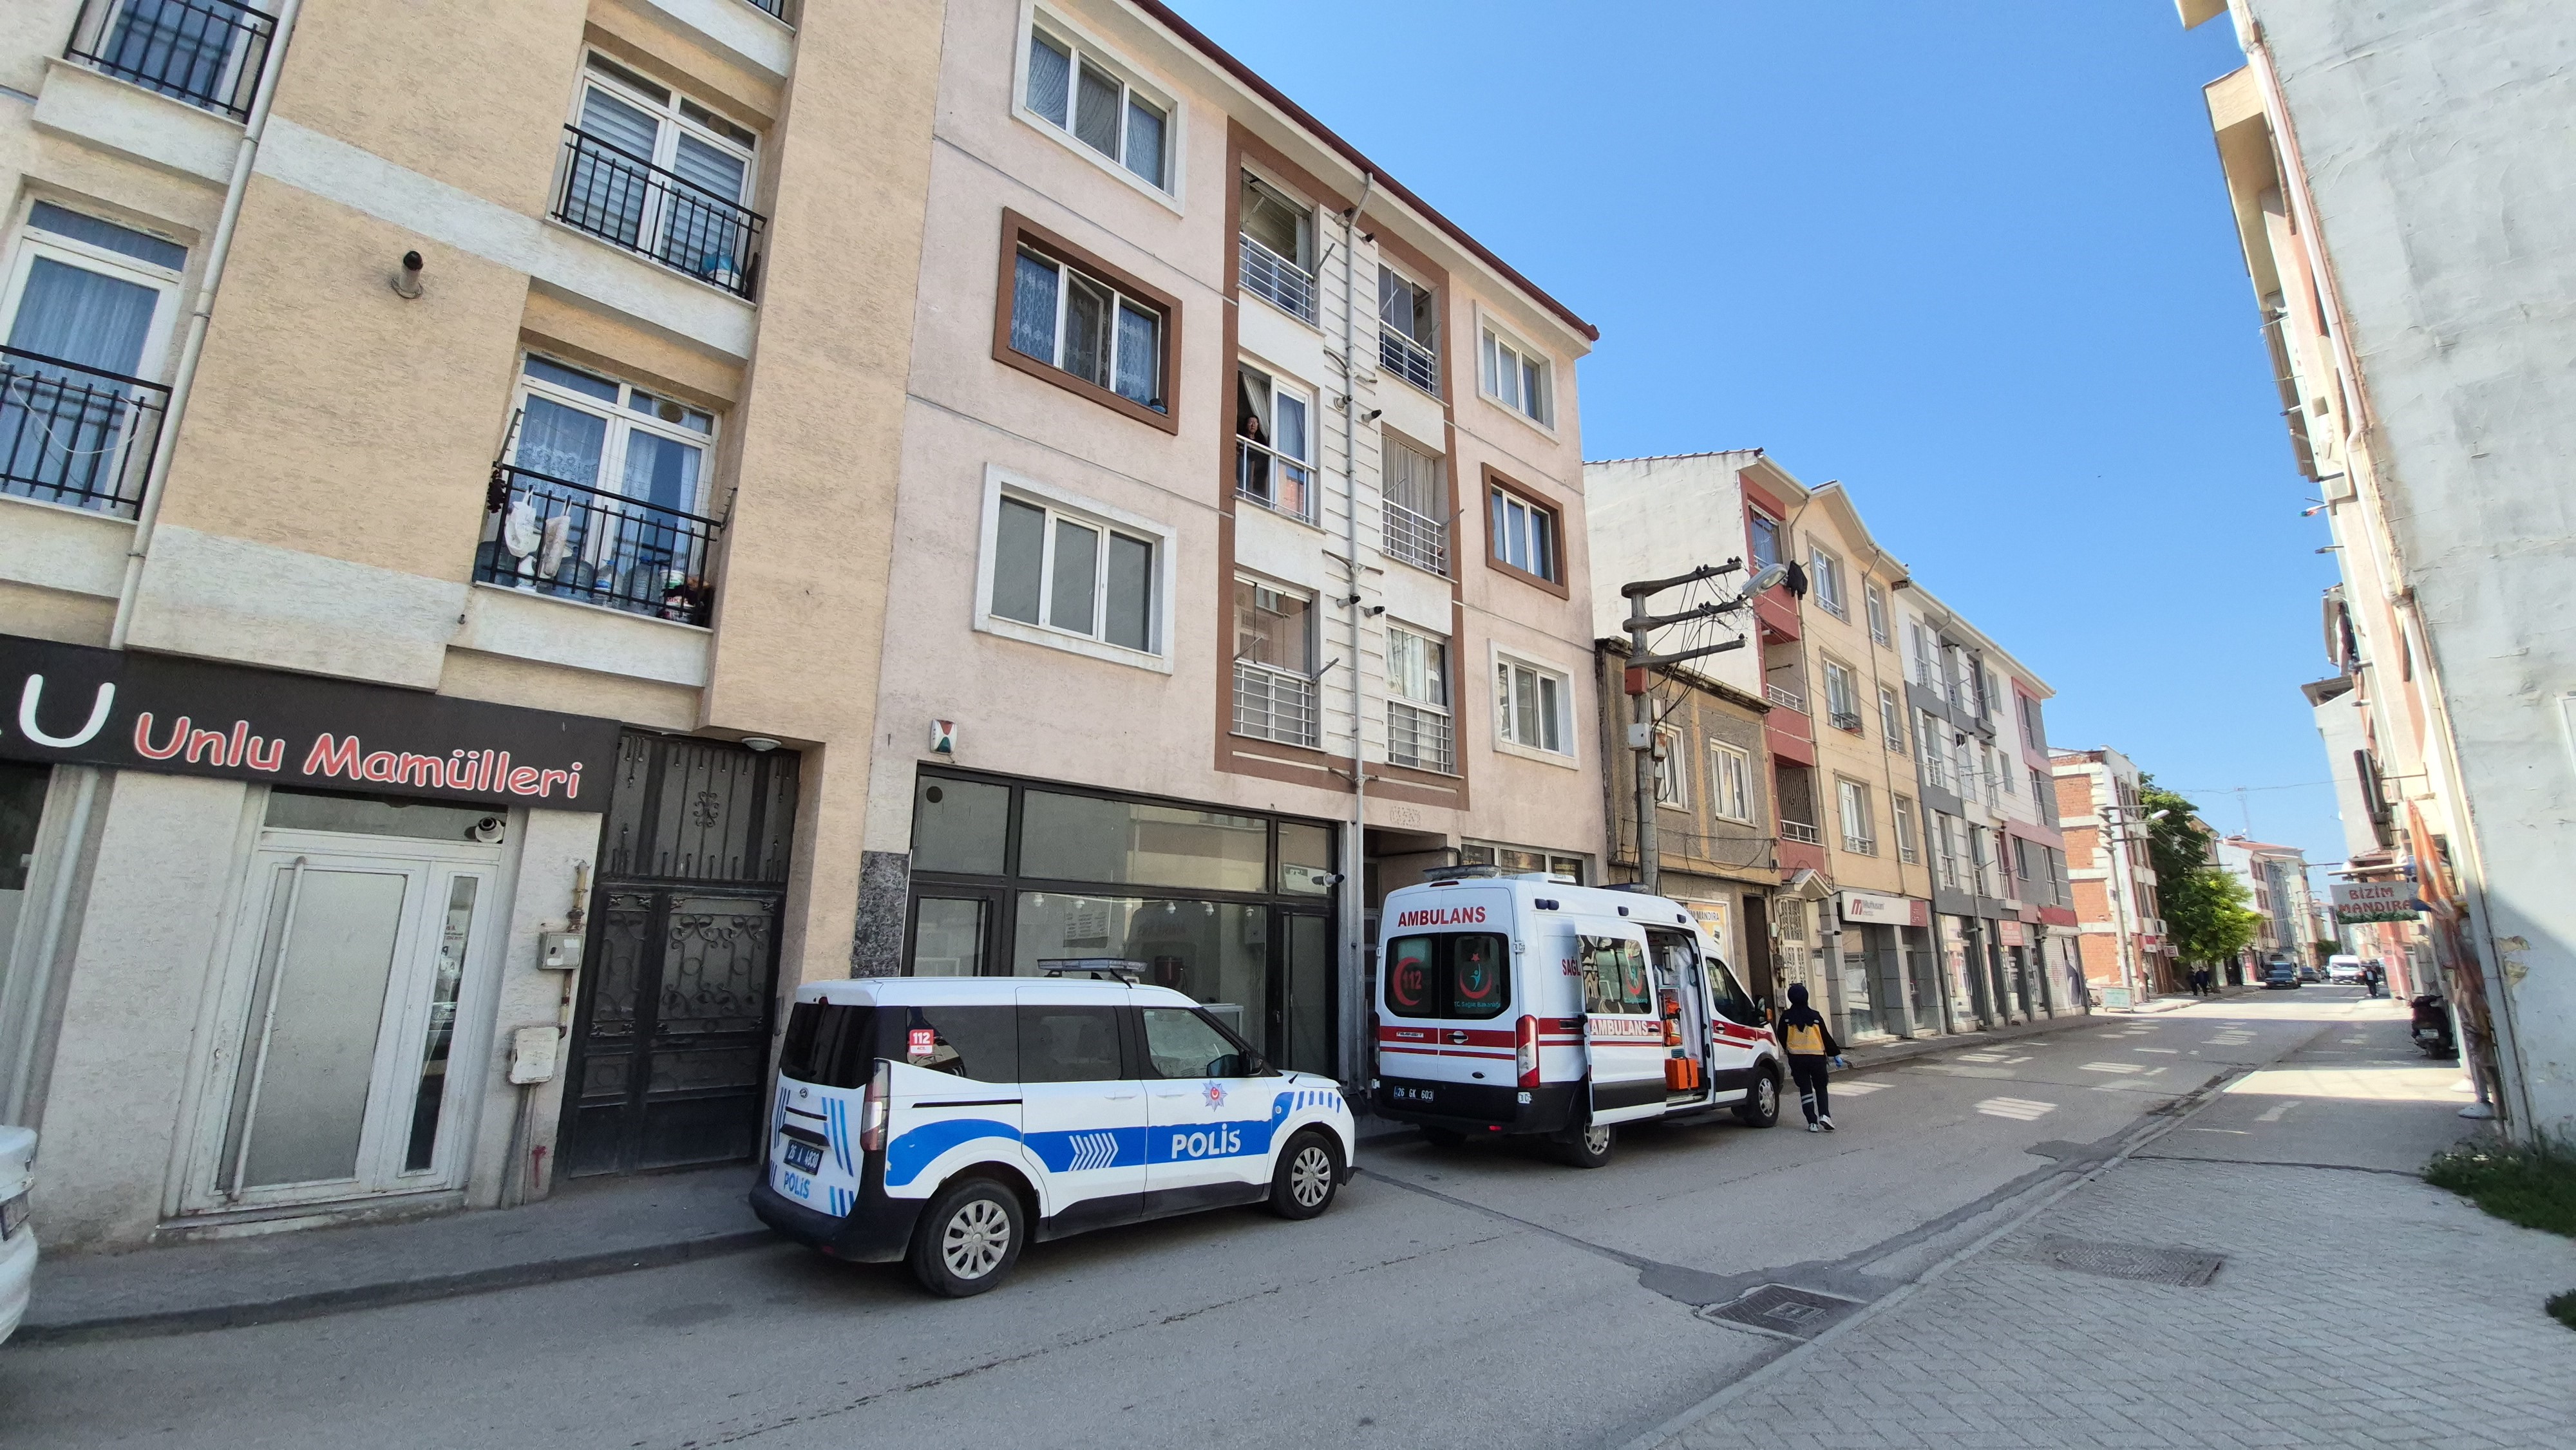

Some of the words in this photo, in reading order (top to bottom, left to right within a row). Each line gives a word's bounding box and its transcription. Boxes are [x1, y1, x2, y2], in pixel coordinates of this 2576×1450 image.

[133, 712, 286, 772] Unlu
[303, 732, 584, 799] Mamülleri
[2349, 885, 2394, 900] BİZİM
[2338, 899, 2412, 914] MANDIRA
[1397, 906, 1486, 927] AMBULANS
[1696, 910, 1719, 921] MANDIRA
[1402, 970, 1422, 990] 112
[1591, 1019, 1649, 1036] AMBULANS
[913, 1032, 931, 1044] 112
[1397, 1088, 1405, 1097] 26
[1409, 1088, 1416, 1098] GK
[1421, 1089, 1433, 1100] 603
[1171, 1123, 1241, 1159] POLİS
[788, 1144, 797, 1160] 26
[783, 1171, 810, 1200] POLİS
